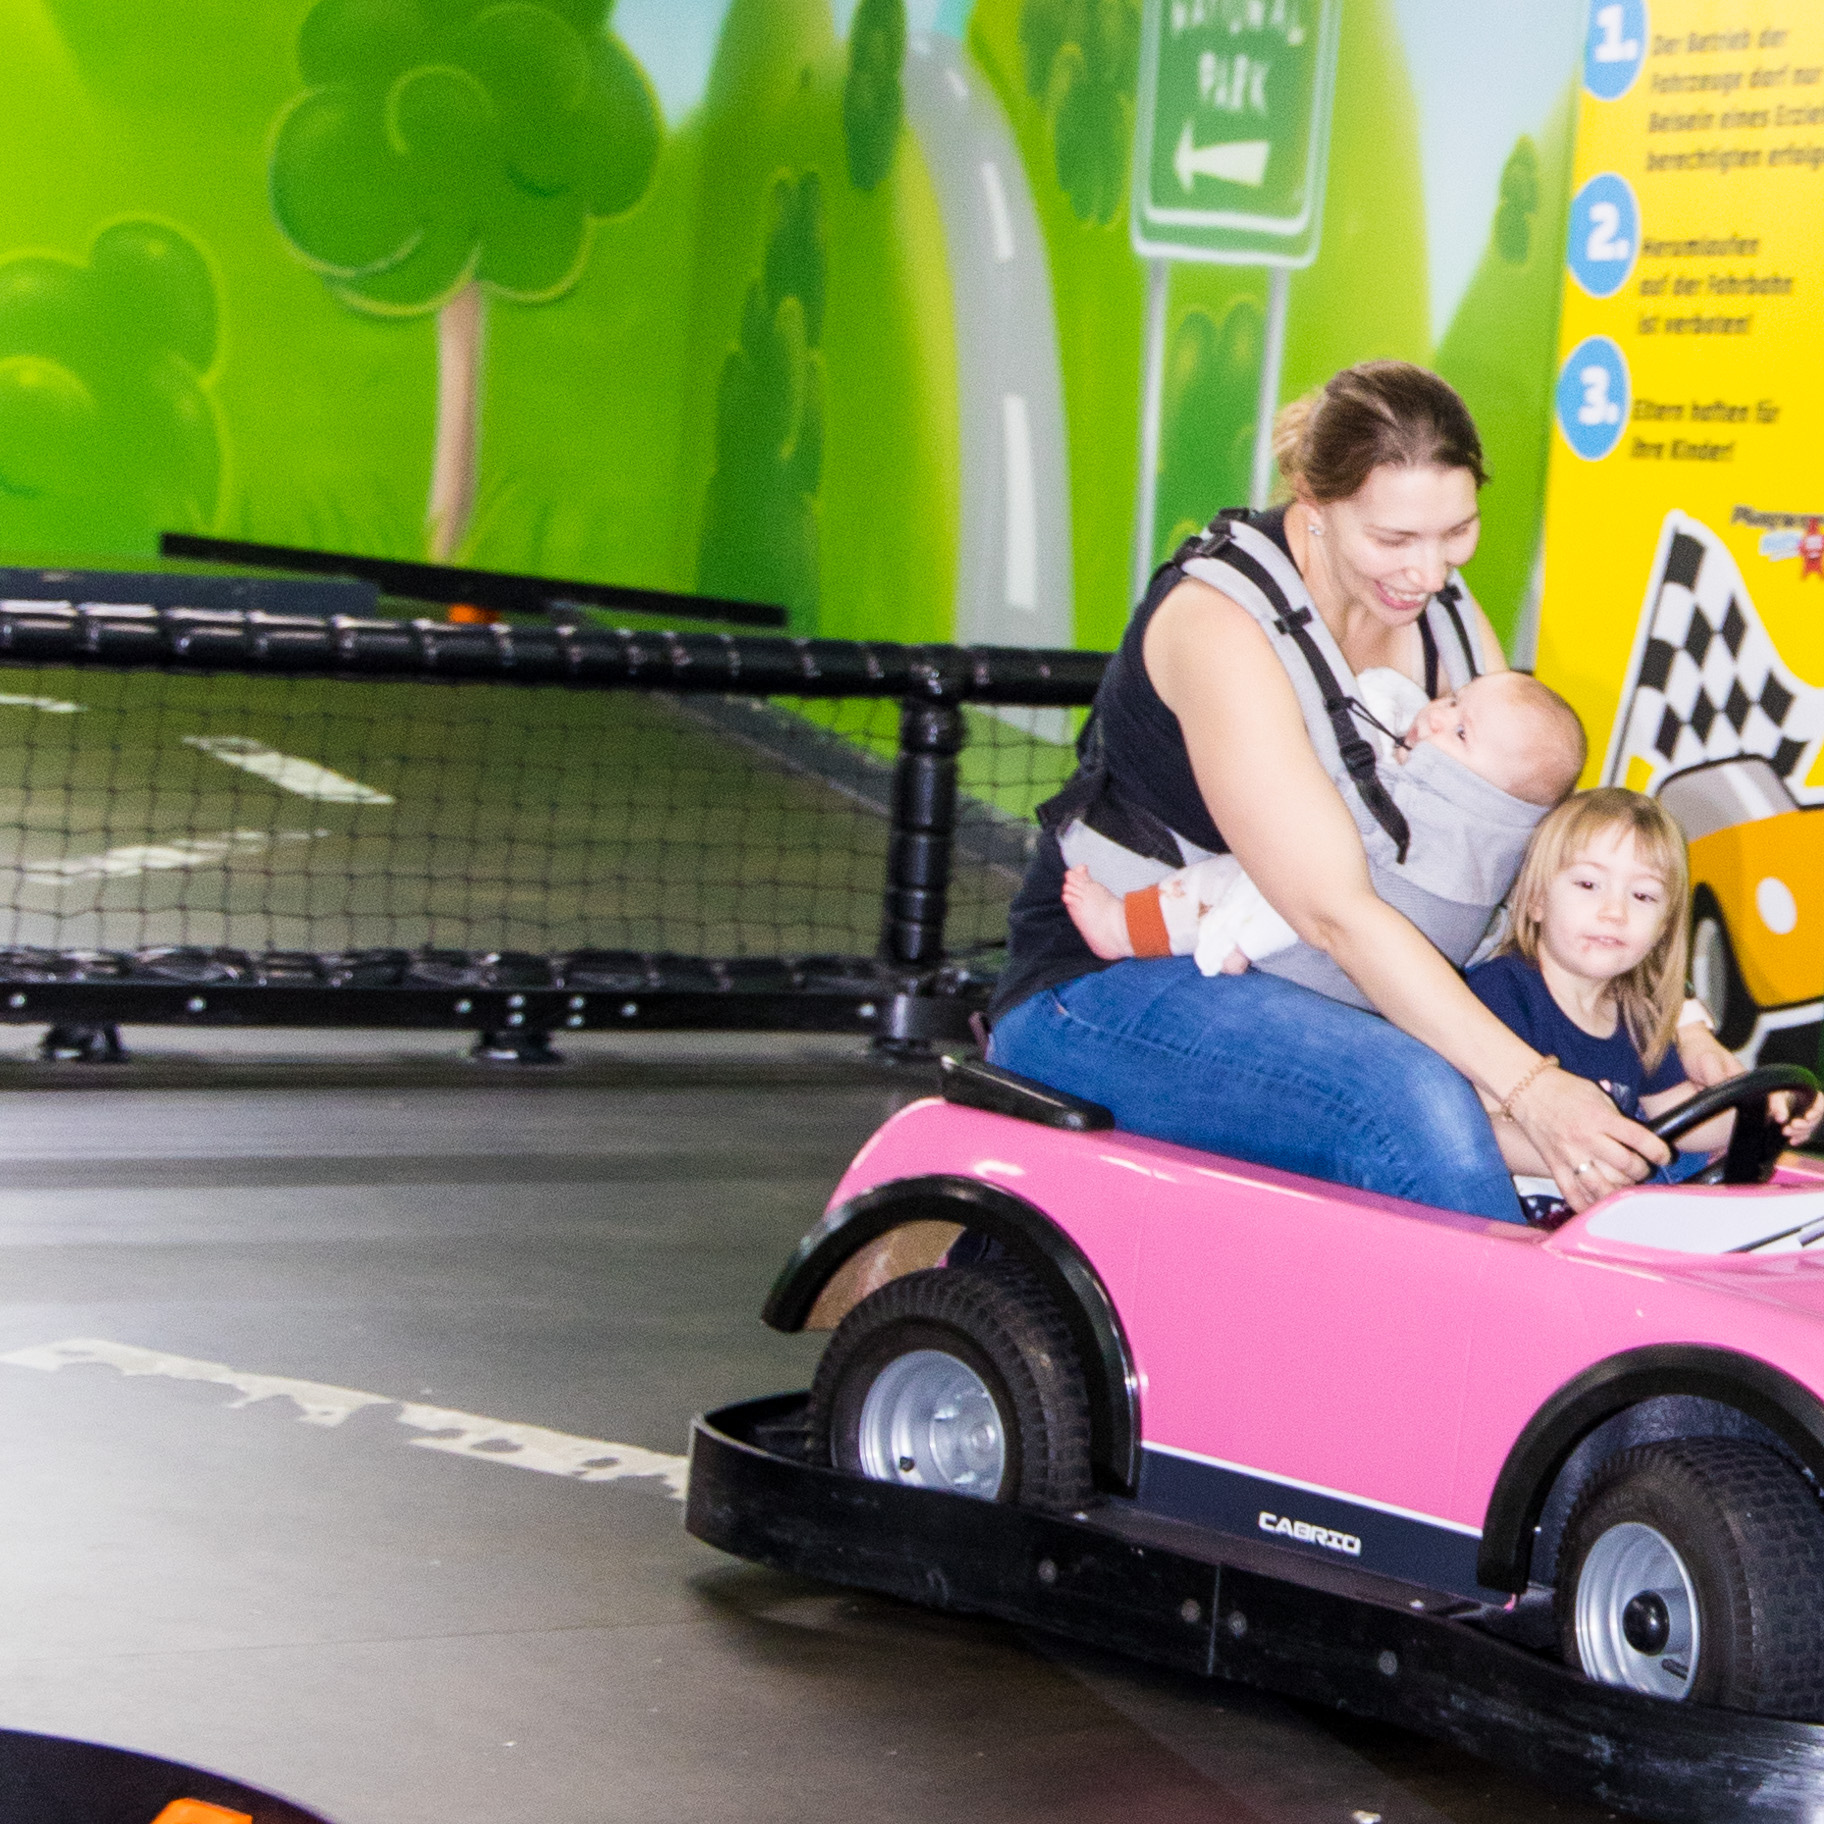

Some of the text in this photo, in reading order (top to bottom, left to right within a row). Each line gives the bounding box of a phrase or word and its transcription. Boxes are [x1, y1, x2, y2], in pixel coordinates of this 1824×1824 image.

[1594, 4, 1639, 63] 1.
[1652, 28, 1789, 56] Der Betrieb der
[1651, 72, 1744, 96] Fahrzeuge
[1649, 108, 1715, 133] Beisein
[1720, 108, 1769, 128] eines
[1647, 147, 1762, 174] berechtigten
[1586, 201, 1630, 262] 2.
[1641, 232, 1760, 258] Herumlaufen
[1639, 272, 1794, 297] auf der Fahrbahn
[1577, 365, 1620, 426] 3.
[1632, 398, 1781, 425] Eltern haften für
[1258, 1510, 1362, 1557] CABRIO
